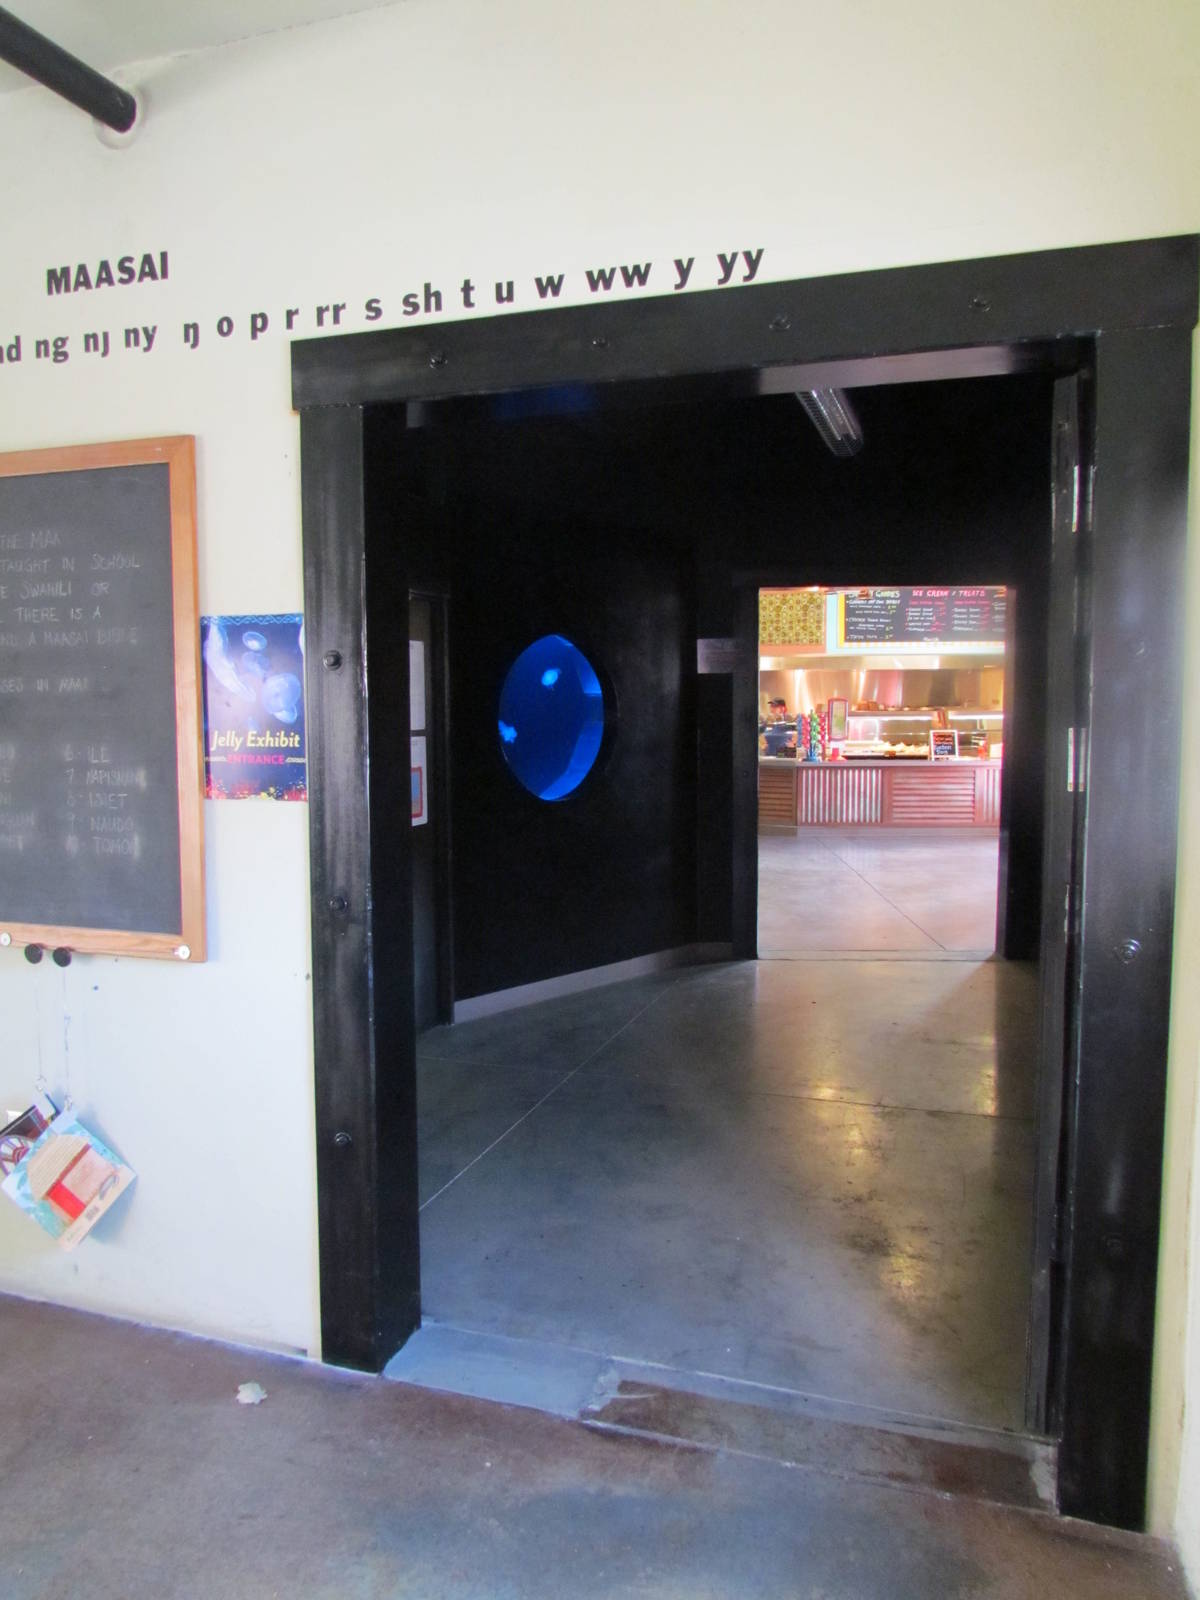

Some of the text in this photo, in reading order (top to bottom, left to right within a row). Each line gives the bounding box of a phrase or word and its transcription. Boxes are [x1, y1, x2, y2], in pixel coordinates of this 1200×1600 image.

[46, 251, 169, 296] MAASAI
[35, 336, 69, 364] ng
[124, 325, 157, 353] ny
[216, 316, 234, 338] o
[250, 312, 269, 340] p
[286, 308, 299, 330] r
[316, 302, 346, 327] rr
[364, 297, 383, 321] s
[401, 282, 442, 316] sh
[460, 279, 475, 308] t
[495, 280, 514, 303] u
[534, 274, 564, 299] w
[585, 262, 652, 293] ww
[674, 257, 695, 290] y
[717, 248, 764, 286] yy
[14, 605, 102, 623] THERE IS A
[210, 730, 300, 752] Jelly Exhibit
